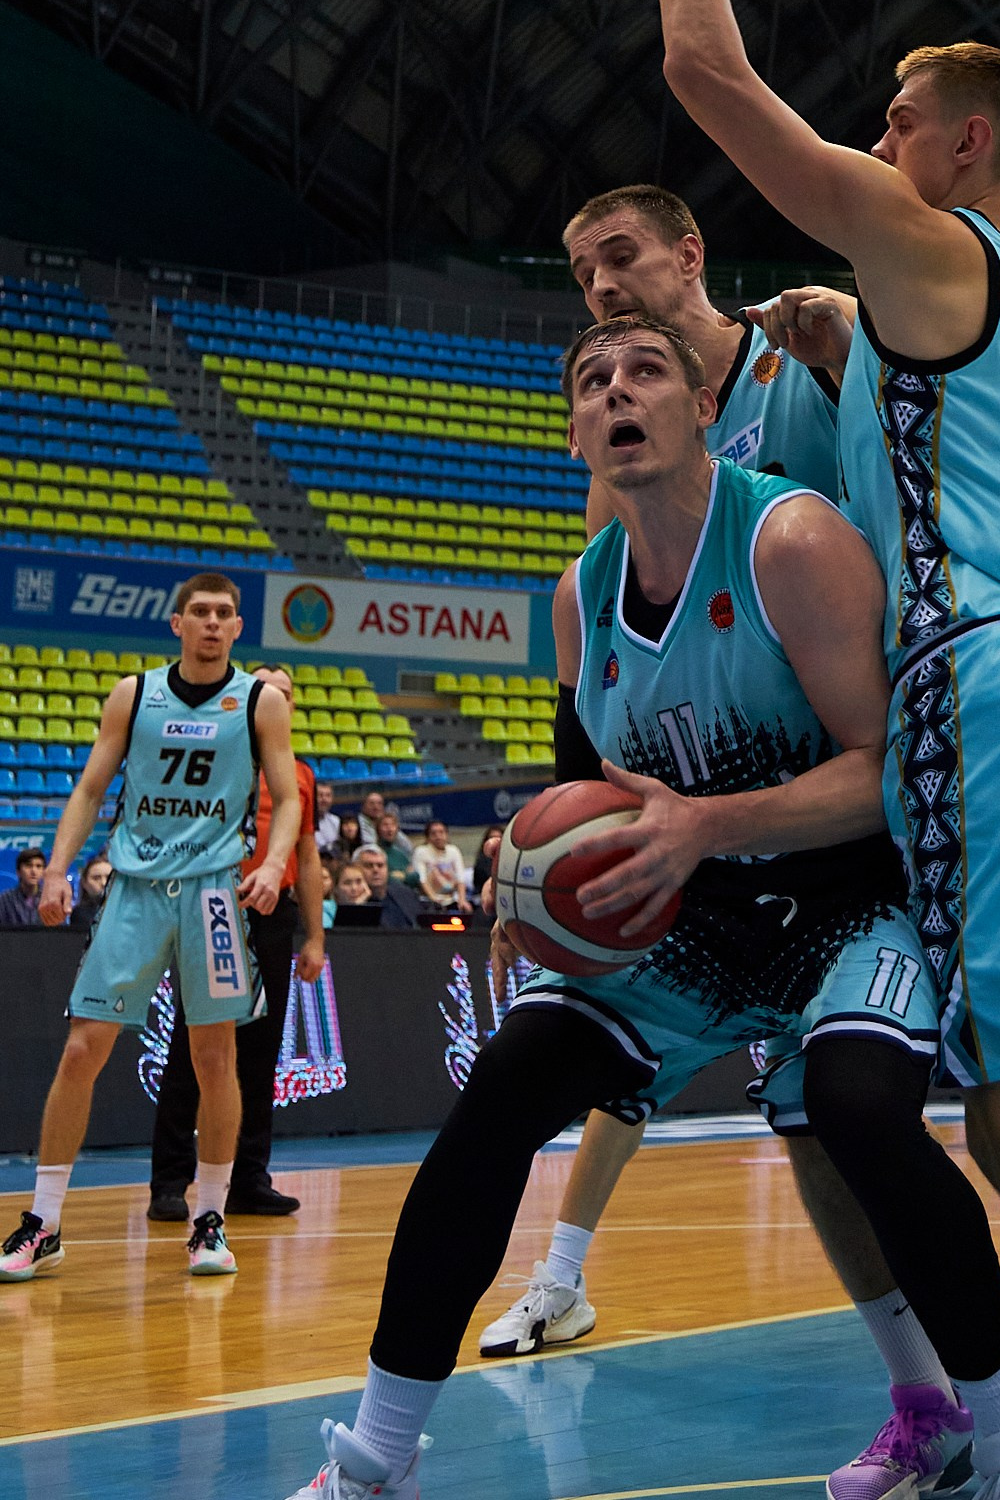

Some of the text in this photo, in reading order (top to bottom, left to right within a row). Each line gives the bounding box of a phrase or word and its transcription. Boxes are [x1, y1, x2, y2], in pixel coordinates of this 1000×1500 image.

[721, 422, 763, 464] BET
[357, 600, 511, 643] ASTANA
[167, 723, 215, 737] 1XBET
[656, 701, 712, 789] 11
[159, 747, 217, 787] 76
[137, 794, 227, 824] ASTANA
[208, 896, 240, 990] 1XBET
[865, 946, 922, 1019] 11
